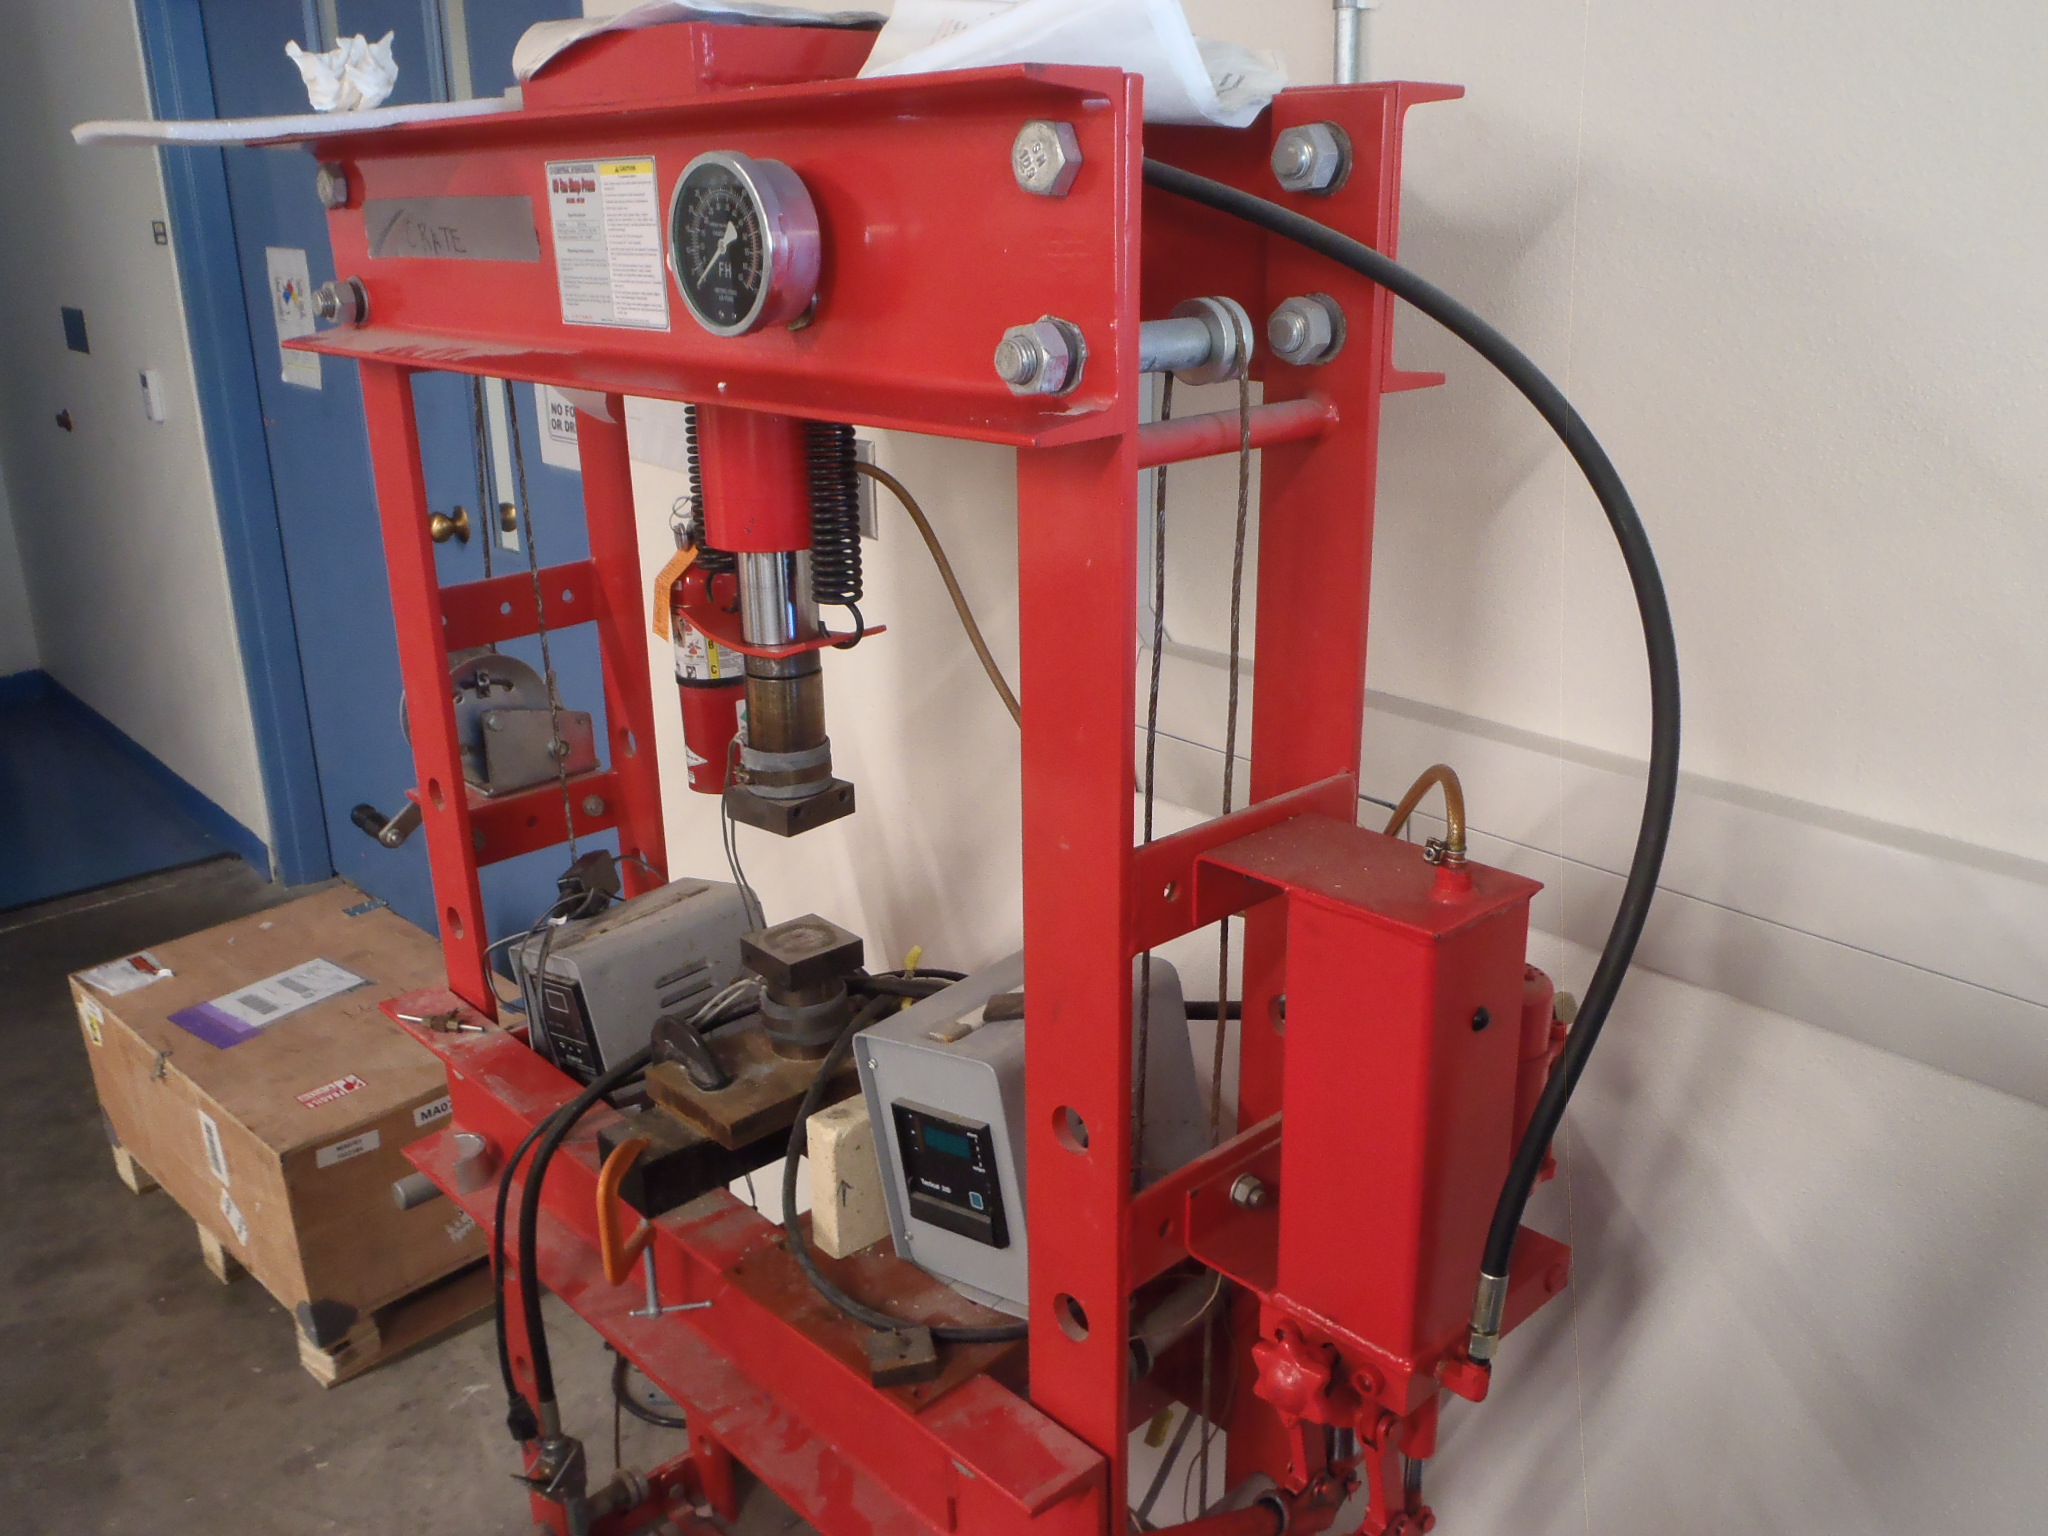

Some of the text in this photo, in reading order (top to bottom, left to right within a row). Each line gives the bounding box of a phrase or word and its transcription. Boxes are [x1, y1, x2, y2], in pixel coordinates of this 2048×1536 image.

[405, 219, 467, 254] CRATE
[718, 262, 732, 279] FH
[551, 403, 563, 416] NO
[551, 418, 563, 431] OR
